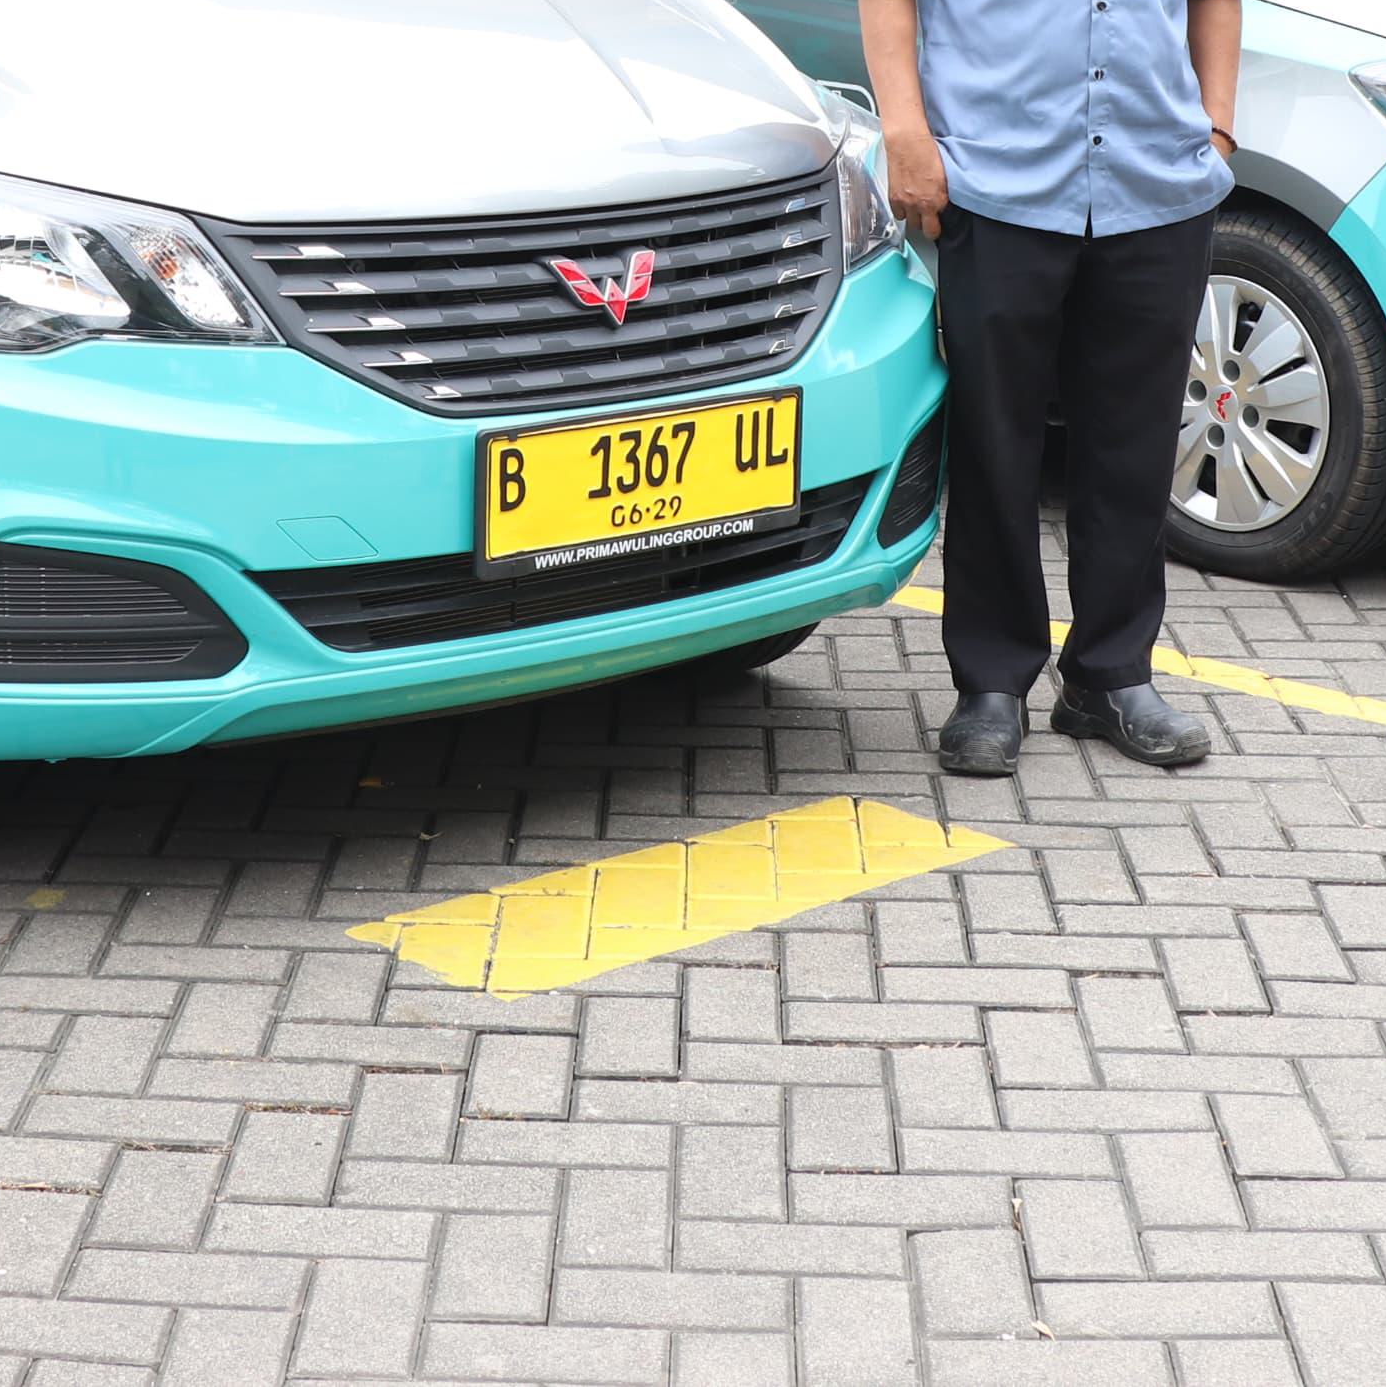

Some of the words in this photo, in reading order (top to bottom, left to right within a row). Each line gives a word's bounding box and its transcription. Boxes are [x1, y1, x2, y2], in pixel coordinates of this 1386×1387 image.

[500, 448, 526, 512] B
[588, 421, 696, 499] 1367
[735, 407, 789, 473] UL
[534, 518, 754, 570] WWW.PRIMAWULINGGROUP.COM
